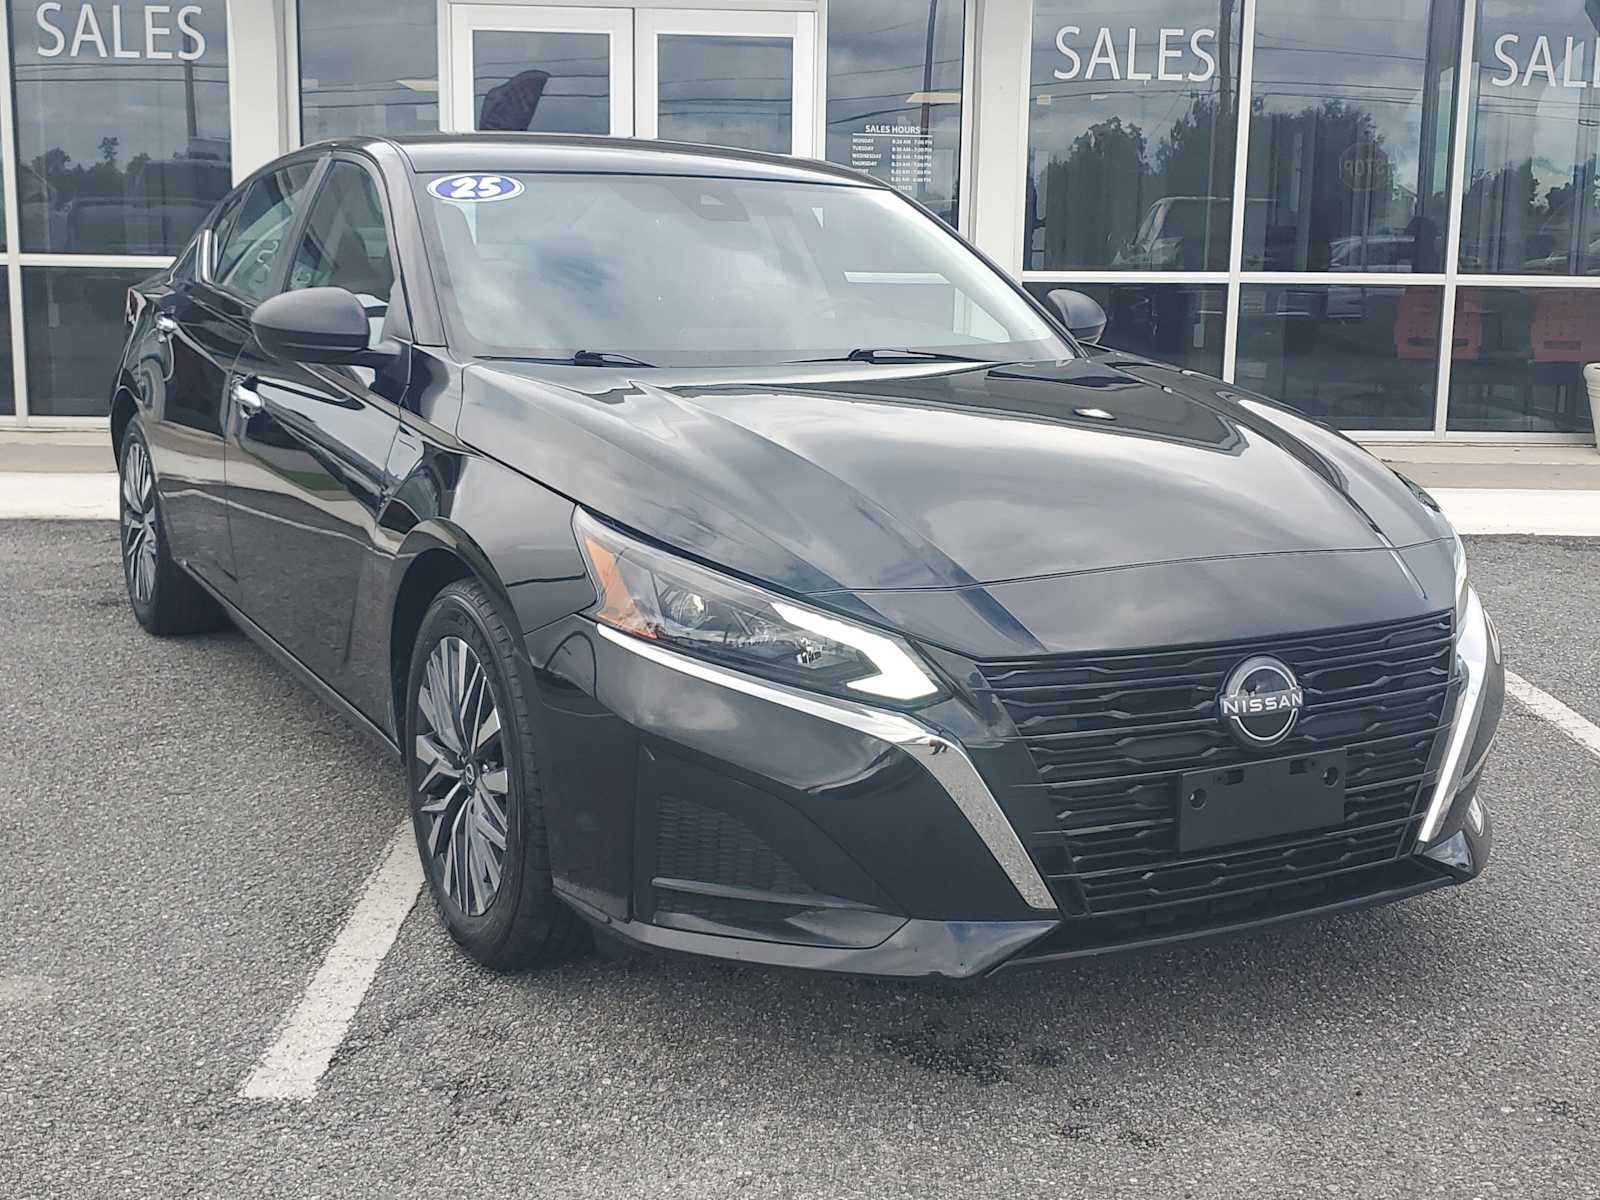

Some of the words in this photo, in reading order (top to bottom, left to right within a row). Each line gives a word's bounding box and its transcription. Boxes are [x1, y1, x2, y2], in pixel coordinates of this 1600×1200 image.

[36, 2, 206, 61] SALES
[1054, 26, 1215, 82] SALES
[865, 125, 890, 133] SALES
[891, 126, 921, 134] HOURS
[450, 176, 502, 199] 25
[1223, 691, 1303, 714] NISSAN
